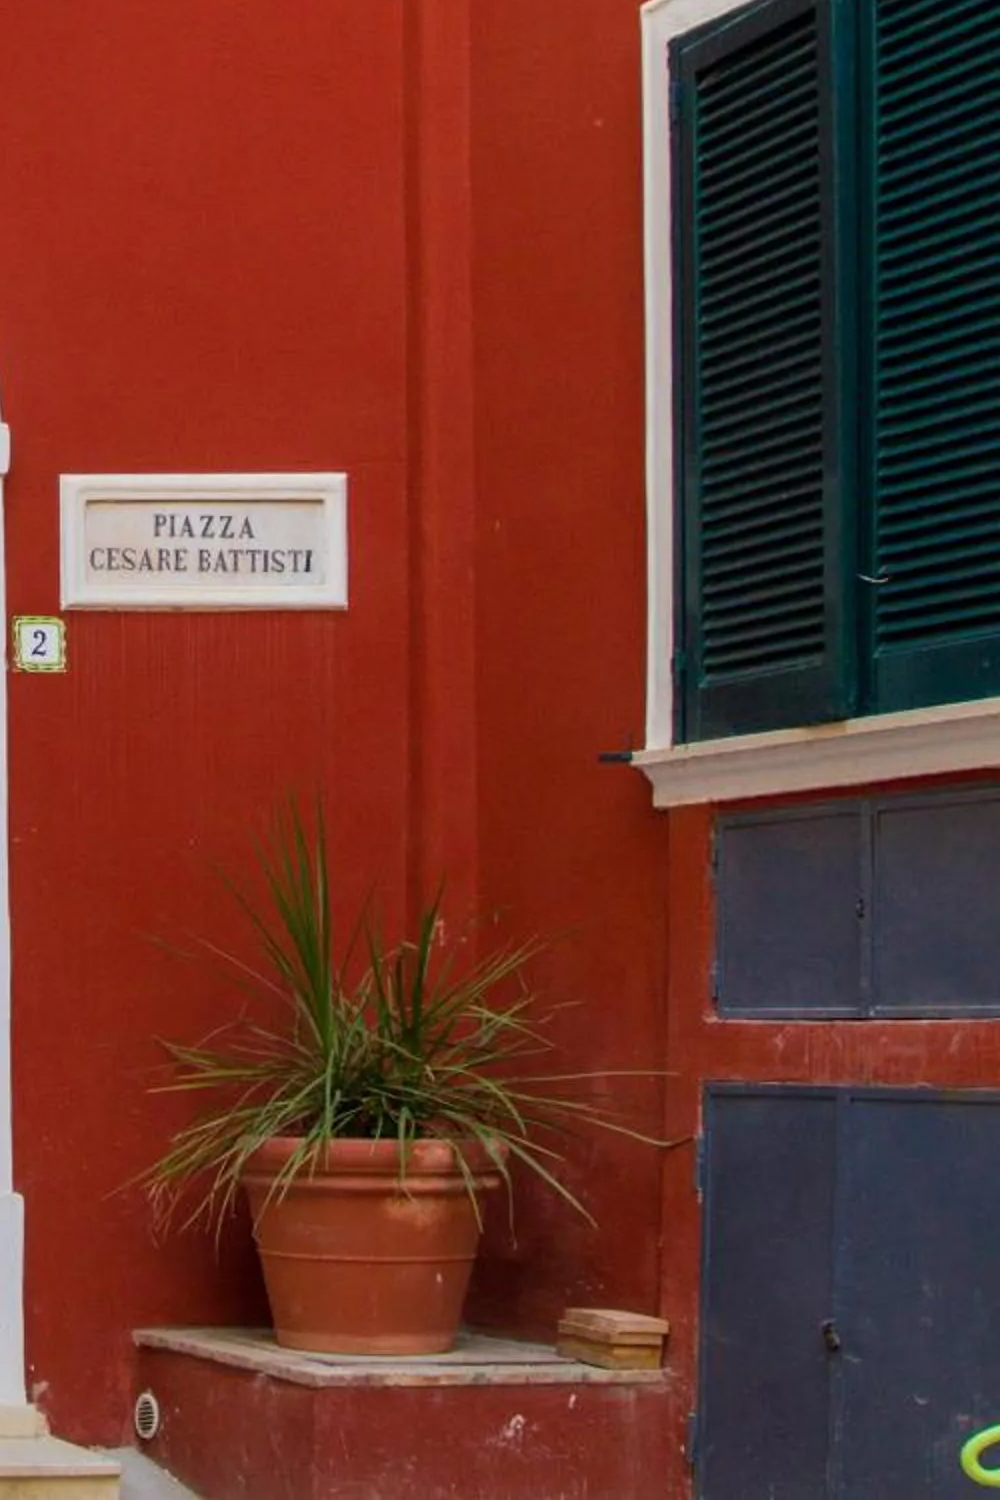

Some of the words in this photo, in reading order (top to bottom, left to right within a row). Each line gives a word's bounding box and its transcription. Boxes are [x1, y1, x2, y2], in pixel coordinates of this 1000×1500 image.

[154, 514, 255, 538] PIAZZA
[89, 547, 188, 572] CESARE
[198, 548, 313, 573] BATTISTI
[31, 629, 47, 657] 2
